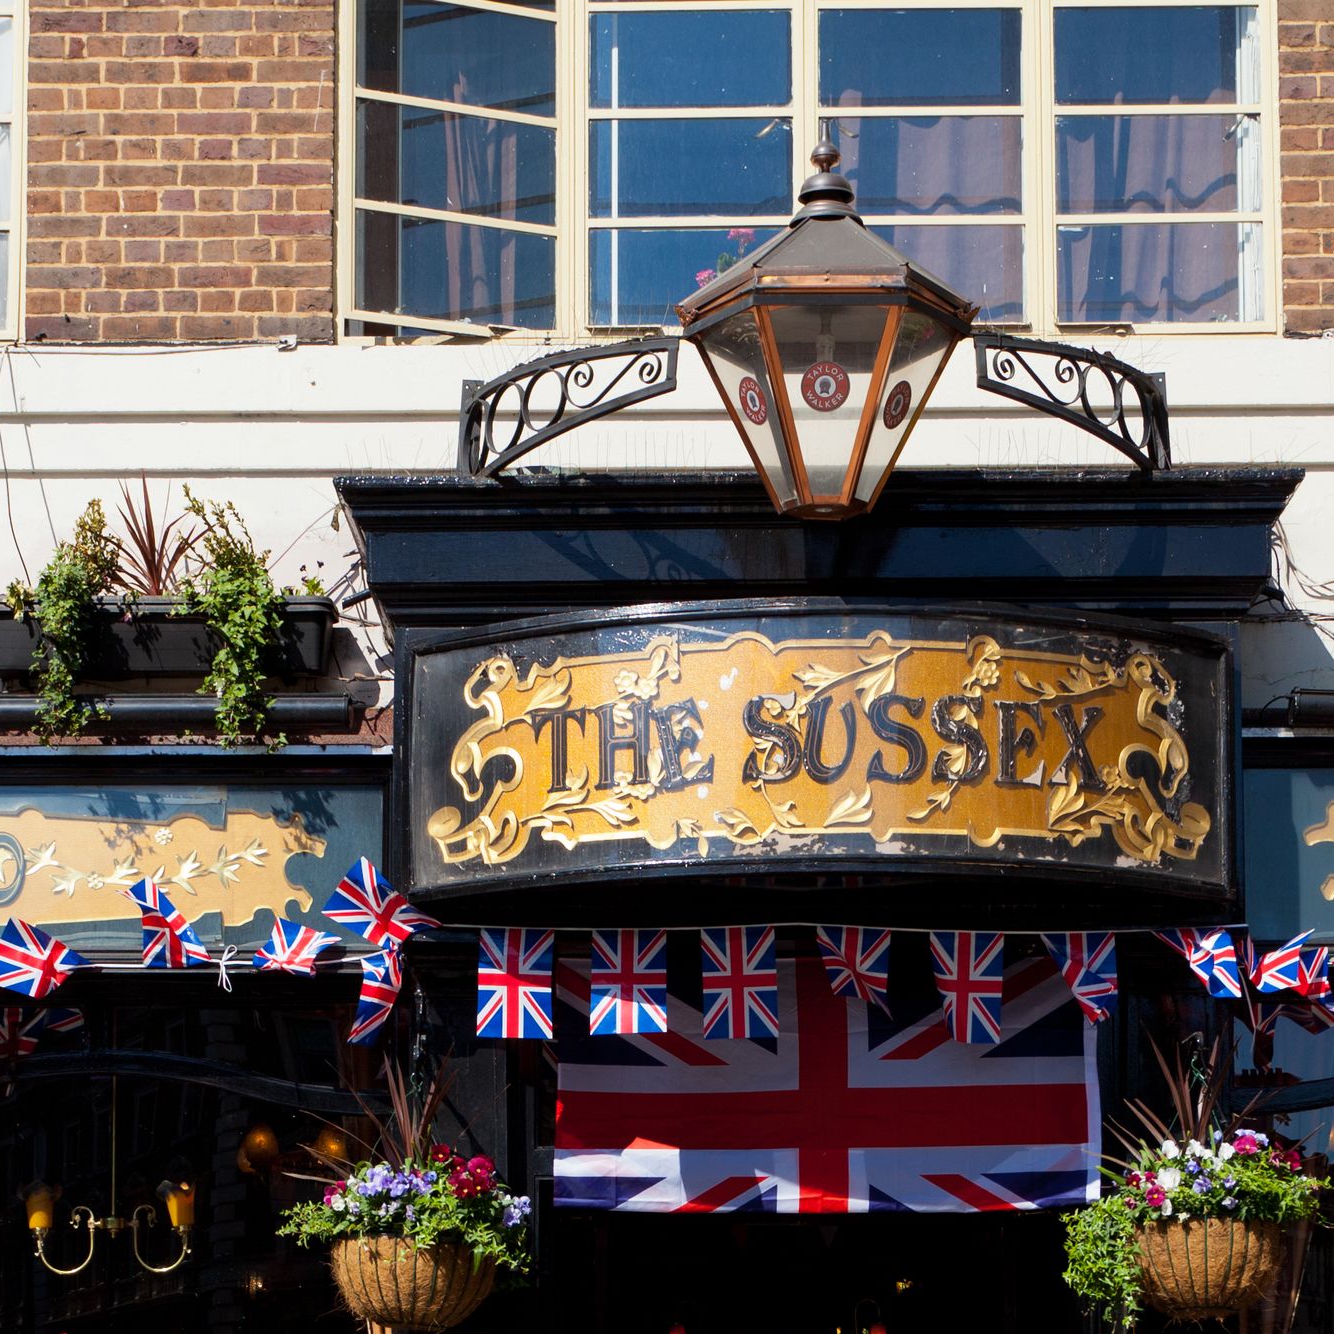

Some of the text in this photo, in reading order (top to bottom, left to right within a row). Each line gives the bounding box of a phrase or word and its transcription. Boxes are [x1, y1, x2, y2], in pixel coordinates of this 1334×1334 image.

[806, 365, 844, 408] TAYLOR WALKER
[530, 692, 1105, 795] THE SUSSEX
